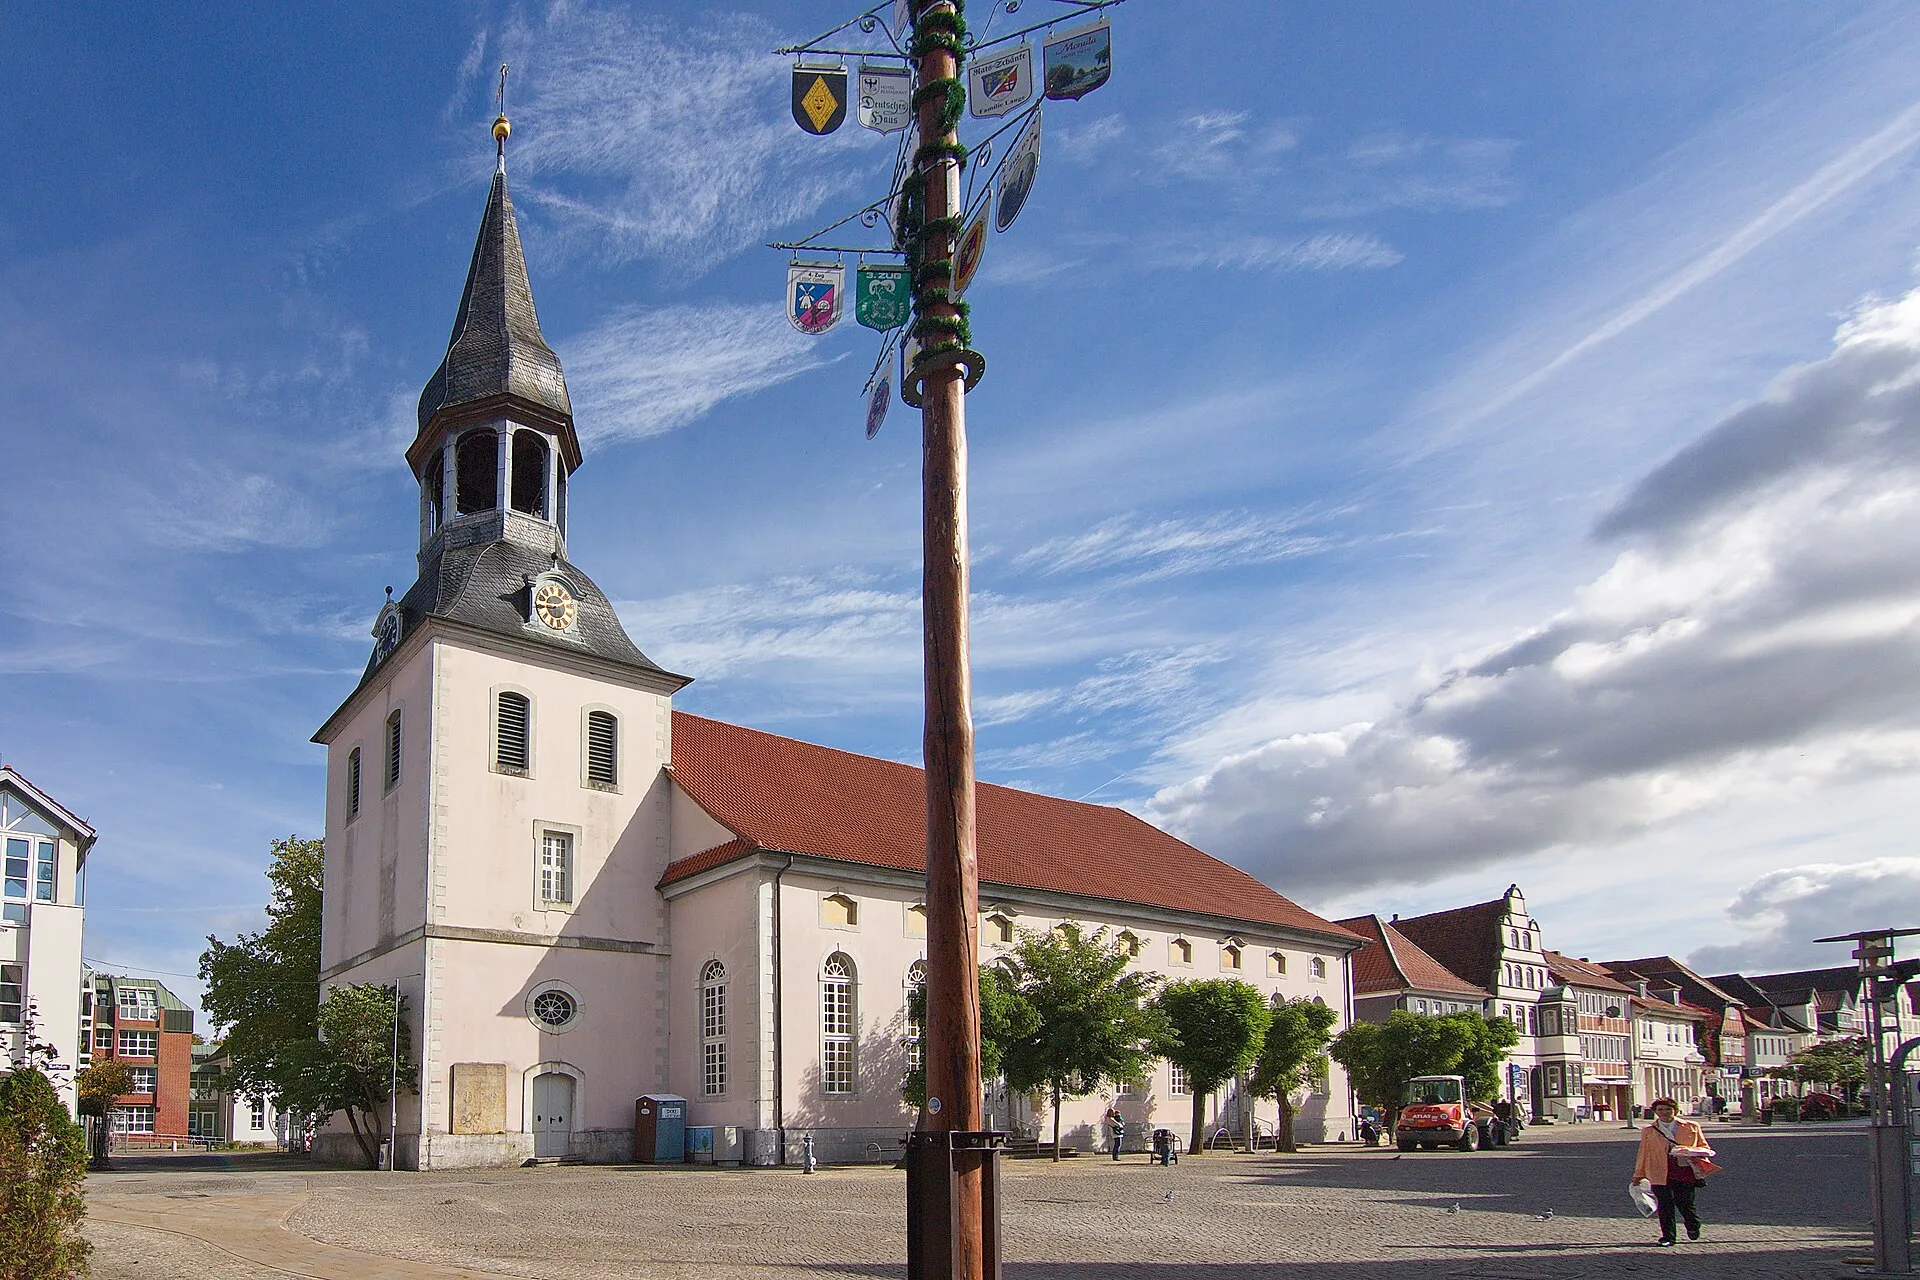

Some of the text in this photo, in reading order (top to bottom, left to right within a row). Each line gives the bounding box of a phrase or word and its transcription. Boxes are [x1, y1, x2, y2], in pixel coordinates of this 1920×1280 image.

[861, 96, 908, 115] Deutsches
[979, 95, 1026, 114] Familie Lange
[871, 111, 898, 126] Haus
